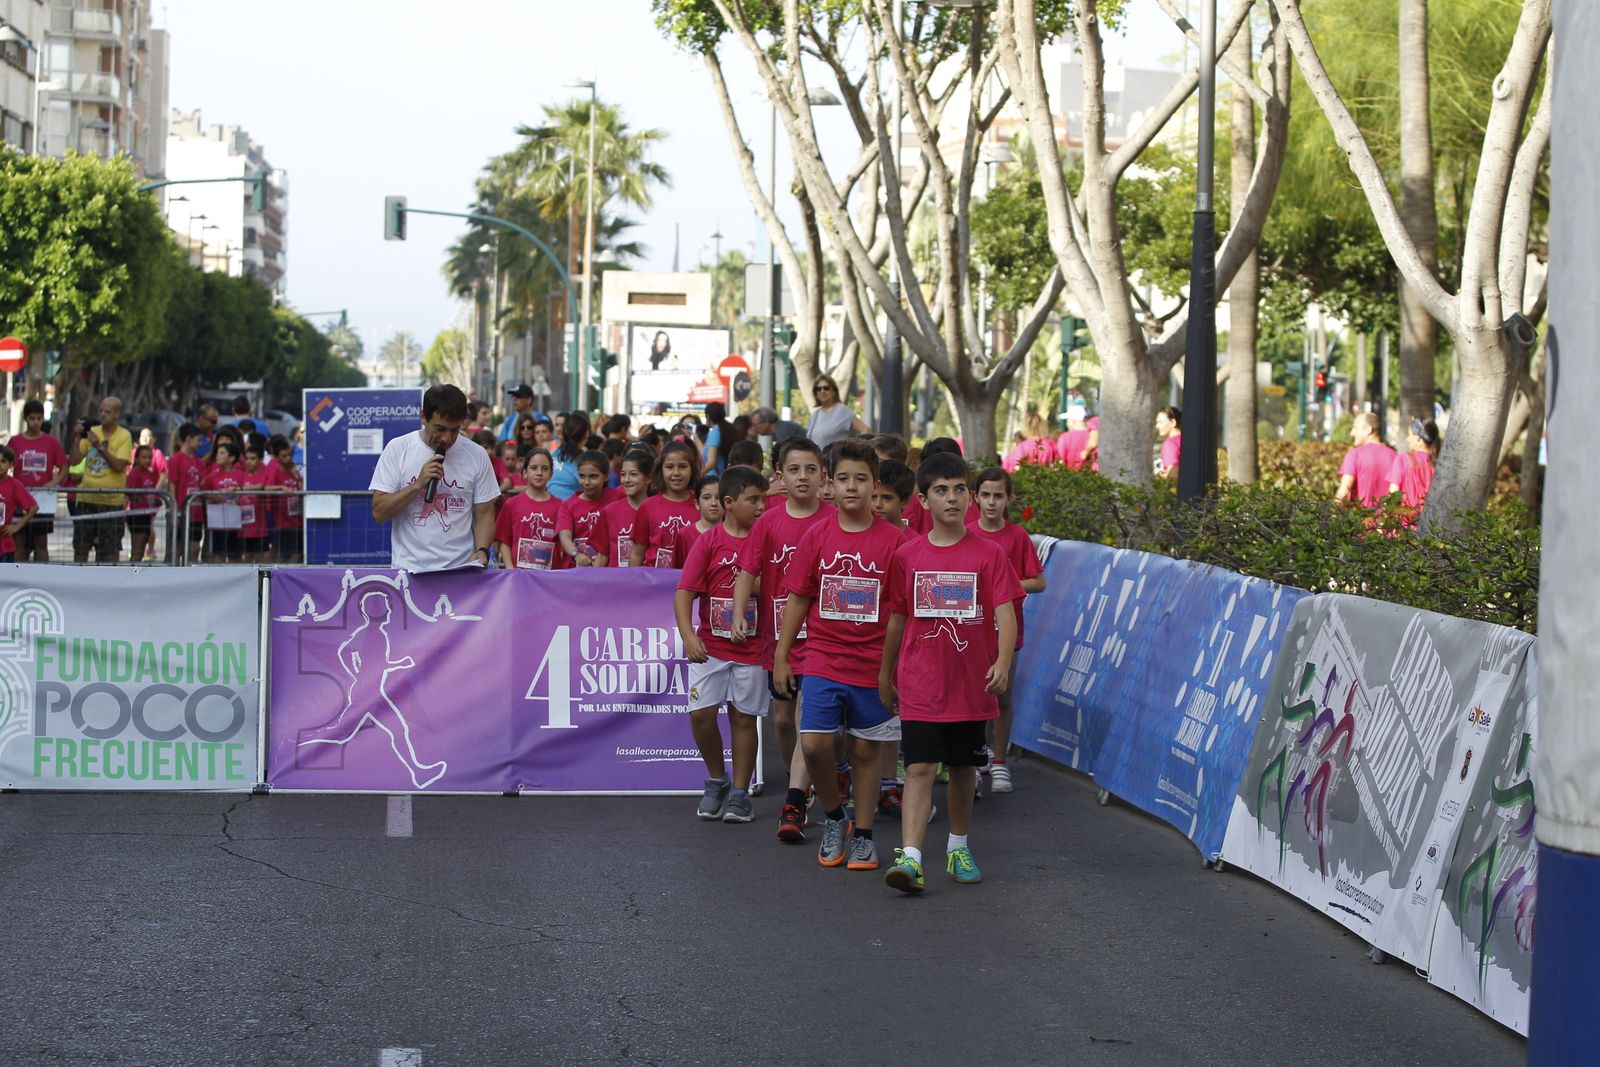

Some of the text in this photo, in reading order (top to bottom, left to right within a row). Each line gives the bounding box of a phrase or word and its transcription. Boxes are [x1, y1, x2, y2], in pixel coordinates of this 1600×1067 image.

[347, 404, 420, 416] COOPERACIÓN
[348, 416, 371, 425] 2005
[932, 586, 972, 600] 1558
[36, 633, 247, 686] FUNDACIÓN
[524, 625, 583, 729] 4
[34, 681, 246, 743] POCO
[578, 703, 594, 713] POR
[596, 703, 611, 713] LAS
[612, 703, 671, 714] ENFERMEDADES
[33, 737, 246, 782] FRECUENTE
